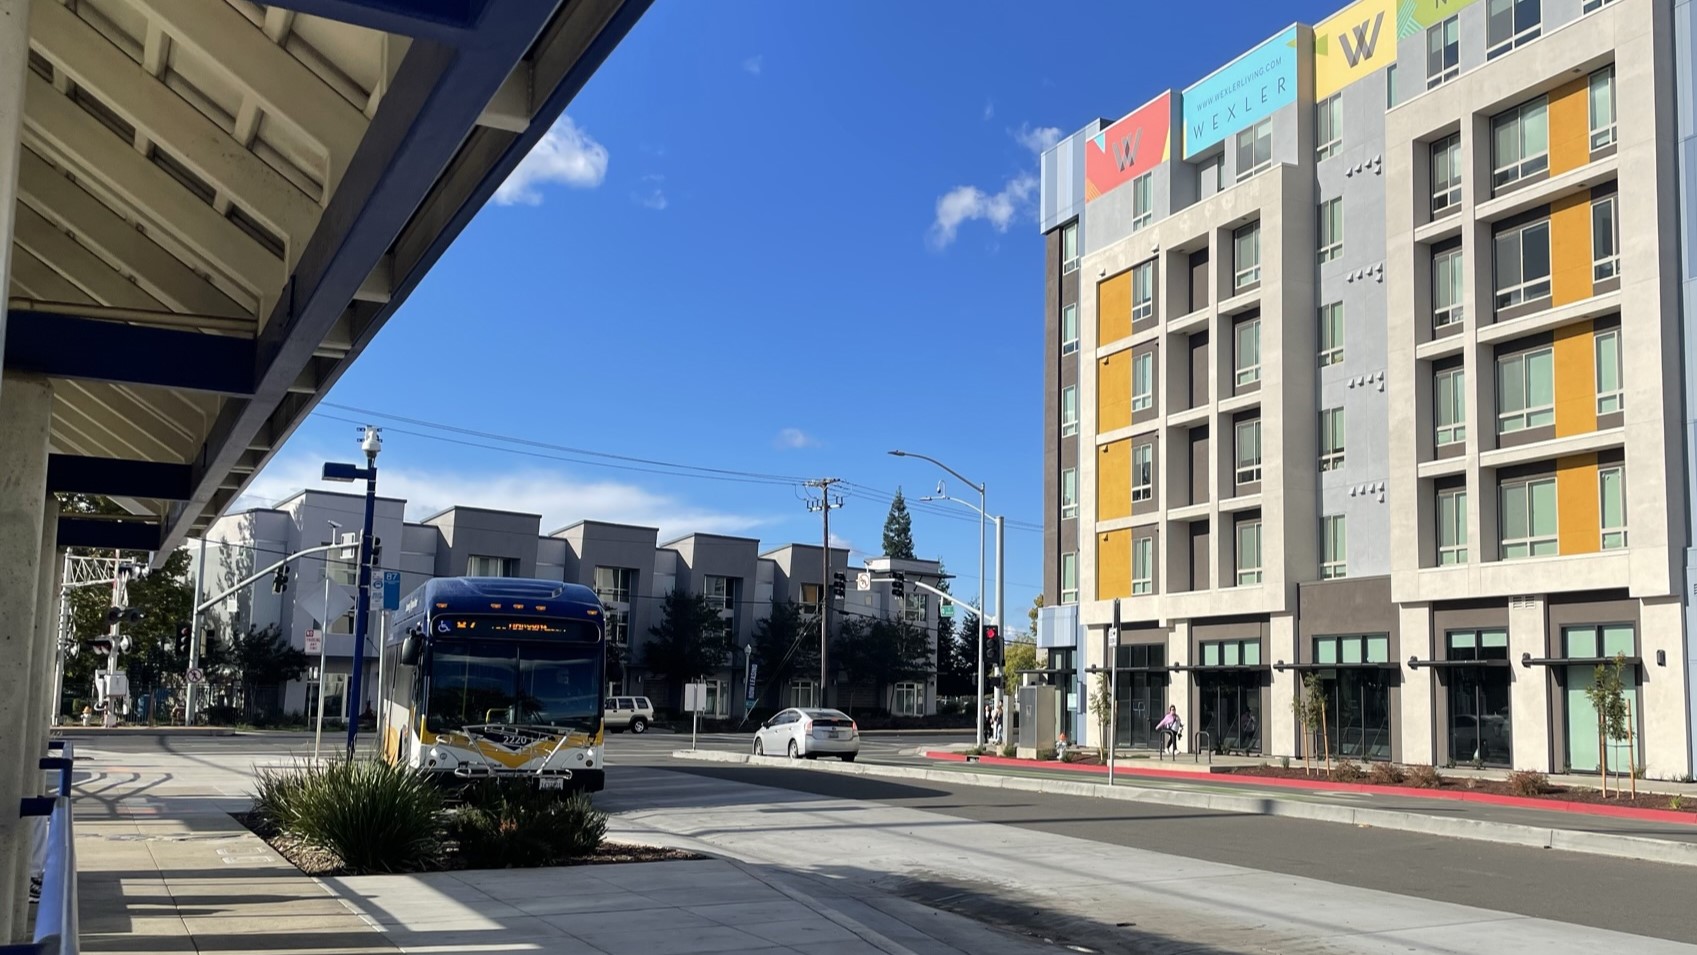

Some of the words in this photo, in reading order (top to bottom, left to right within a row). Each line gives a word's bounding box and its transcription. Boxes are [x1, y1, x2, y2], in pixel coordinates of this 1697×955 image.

[1197, 57, 1282, 112] WWW.WEXLERLIVING.COM
[1193, 76, 1287, 140] WEXLER
[386, 572, 398, 581] 87
[503, 735, 527, 745] 2220
